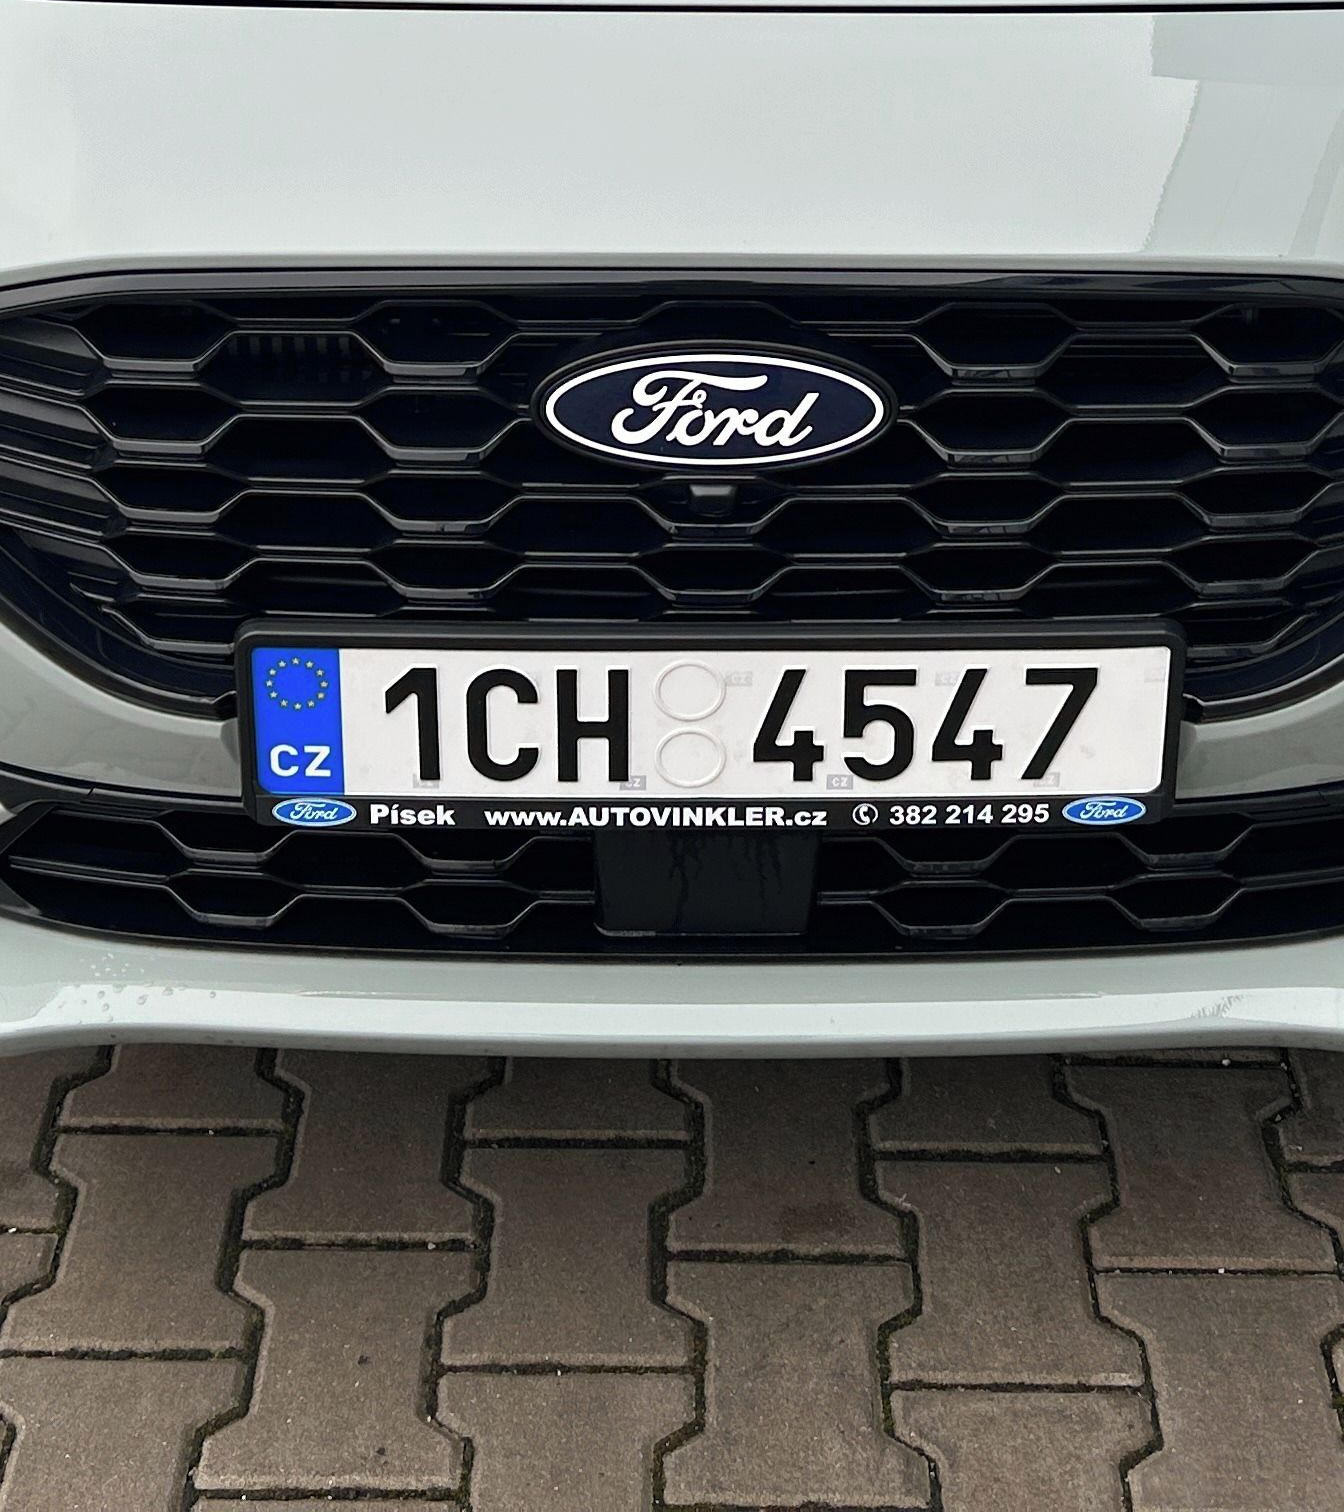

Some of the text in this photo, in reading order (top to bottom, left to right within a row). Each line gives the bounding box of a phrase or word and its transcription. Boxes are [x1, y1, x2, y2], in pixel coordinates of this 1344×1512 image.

[610, 370, 820, 447] Ford
[384, 666, 1099, 782] 1CH 4547
[269, 743, 332, 778] CZ
[370, 803, 456, 826] Písek
[483, 806, 828, 827] www.AUTOVINKLER.cz
[889, 805, 937, 825] 382
[944, 804, 994, 824] 214
[1001, 803, 1050, 824] 295
